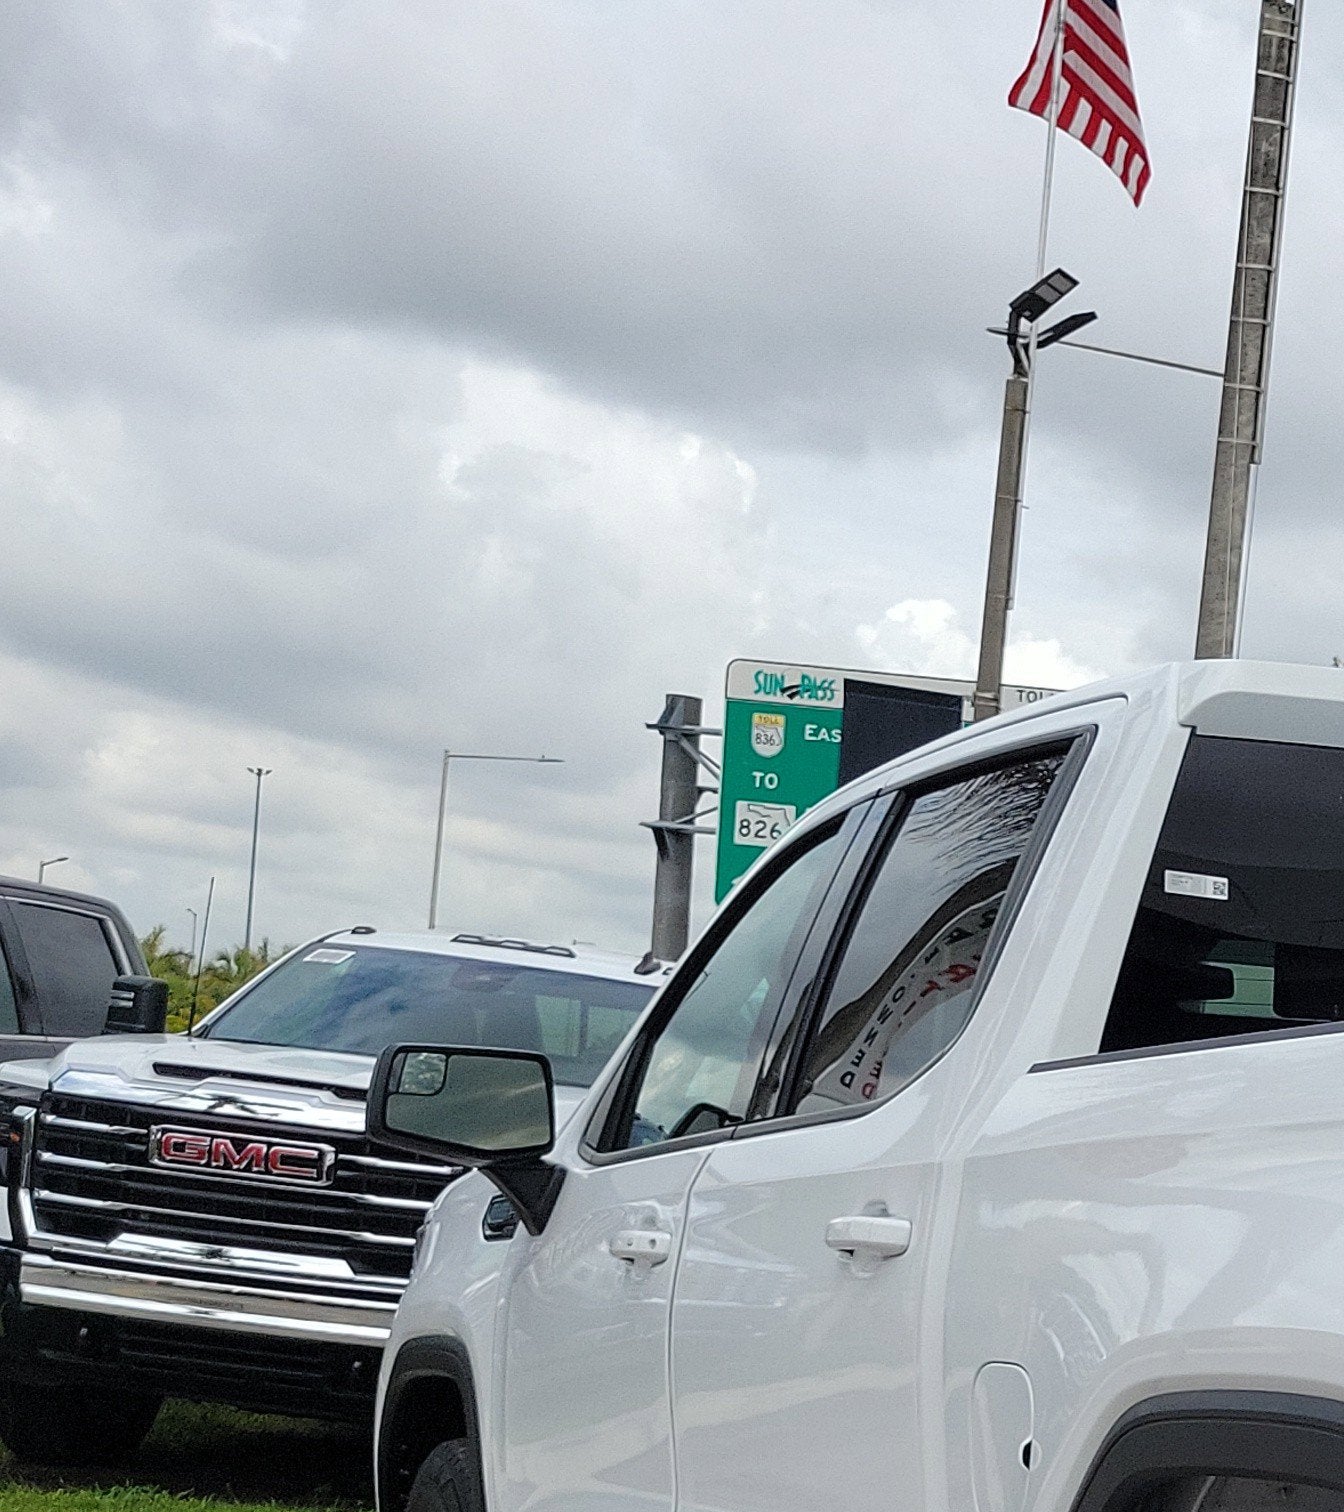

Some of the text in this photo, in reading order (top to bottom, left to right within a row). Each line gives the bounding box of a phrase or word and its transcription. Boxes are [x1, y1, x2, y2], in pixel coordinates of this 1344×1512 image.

[754, 670, 785, 697] SUN
[755, 714, 780, 725] TOLL
[755, 732, 776, 747] 836
[804, 724, 842, 743] EAS
[752, 771, 779, 789] TO
[738, 818, 782, 840] 826
[161, 1132, 320, 1178] GMC
